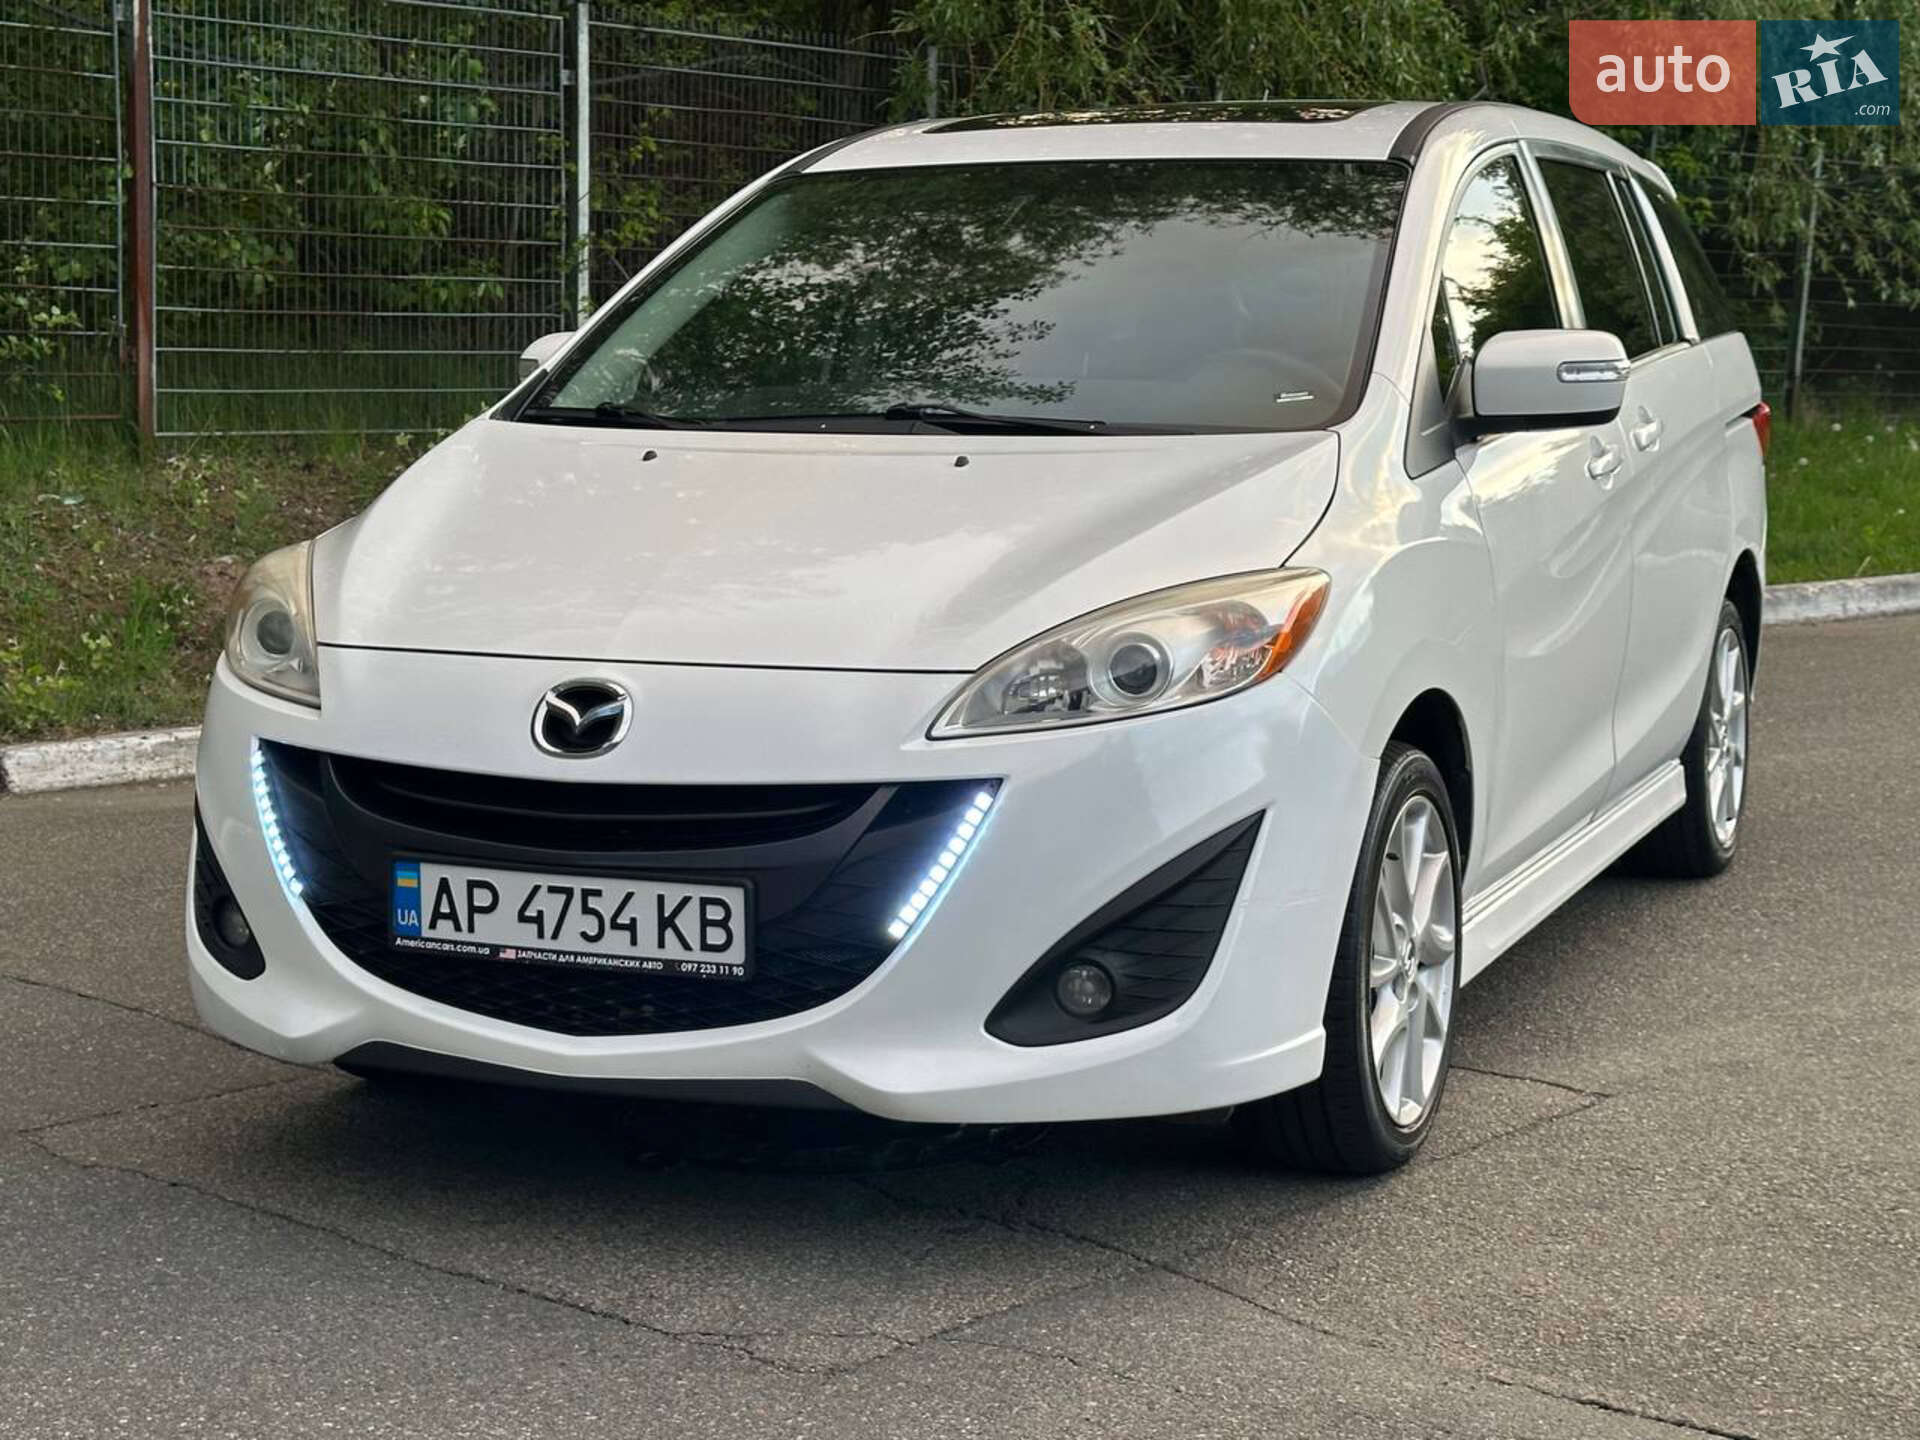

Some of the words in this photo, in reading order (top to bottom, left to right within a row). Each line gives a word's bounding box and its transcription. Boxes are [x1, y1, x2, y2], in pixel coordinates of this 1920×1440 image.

[397, 909, 419, 927] UA
[428, 876, 500, 934] AP
[517, 883, 638, 947] 4754
[657, 893, 733, 954] KB
[395, 937, 490, 955] Americancars.com.ua
[517, 949, 557, 962] ЗАПЧАСТИ
[558, 954, 574, 963] ДЛЯ
[575, 955, 640, 968] АМЕРИКАНСКИХ
[642, 961, 664, 970] АВТО
[681, 962, 697, 972] 097
[700, 964, 716, 974] 233
[719, 965, 729, 975] 11
[732, 966, 744, 976] 90
